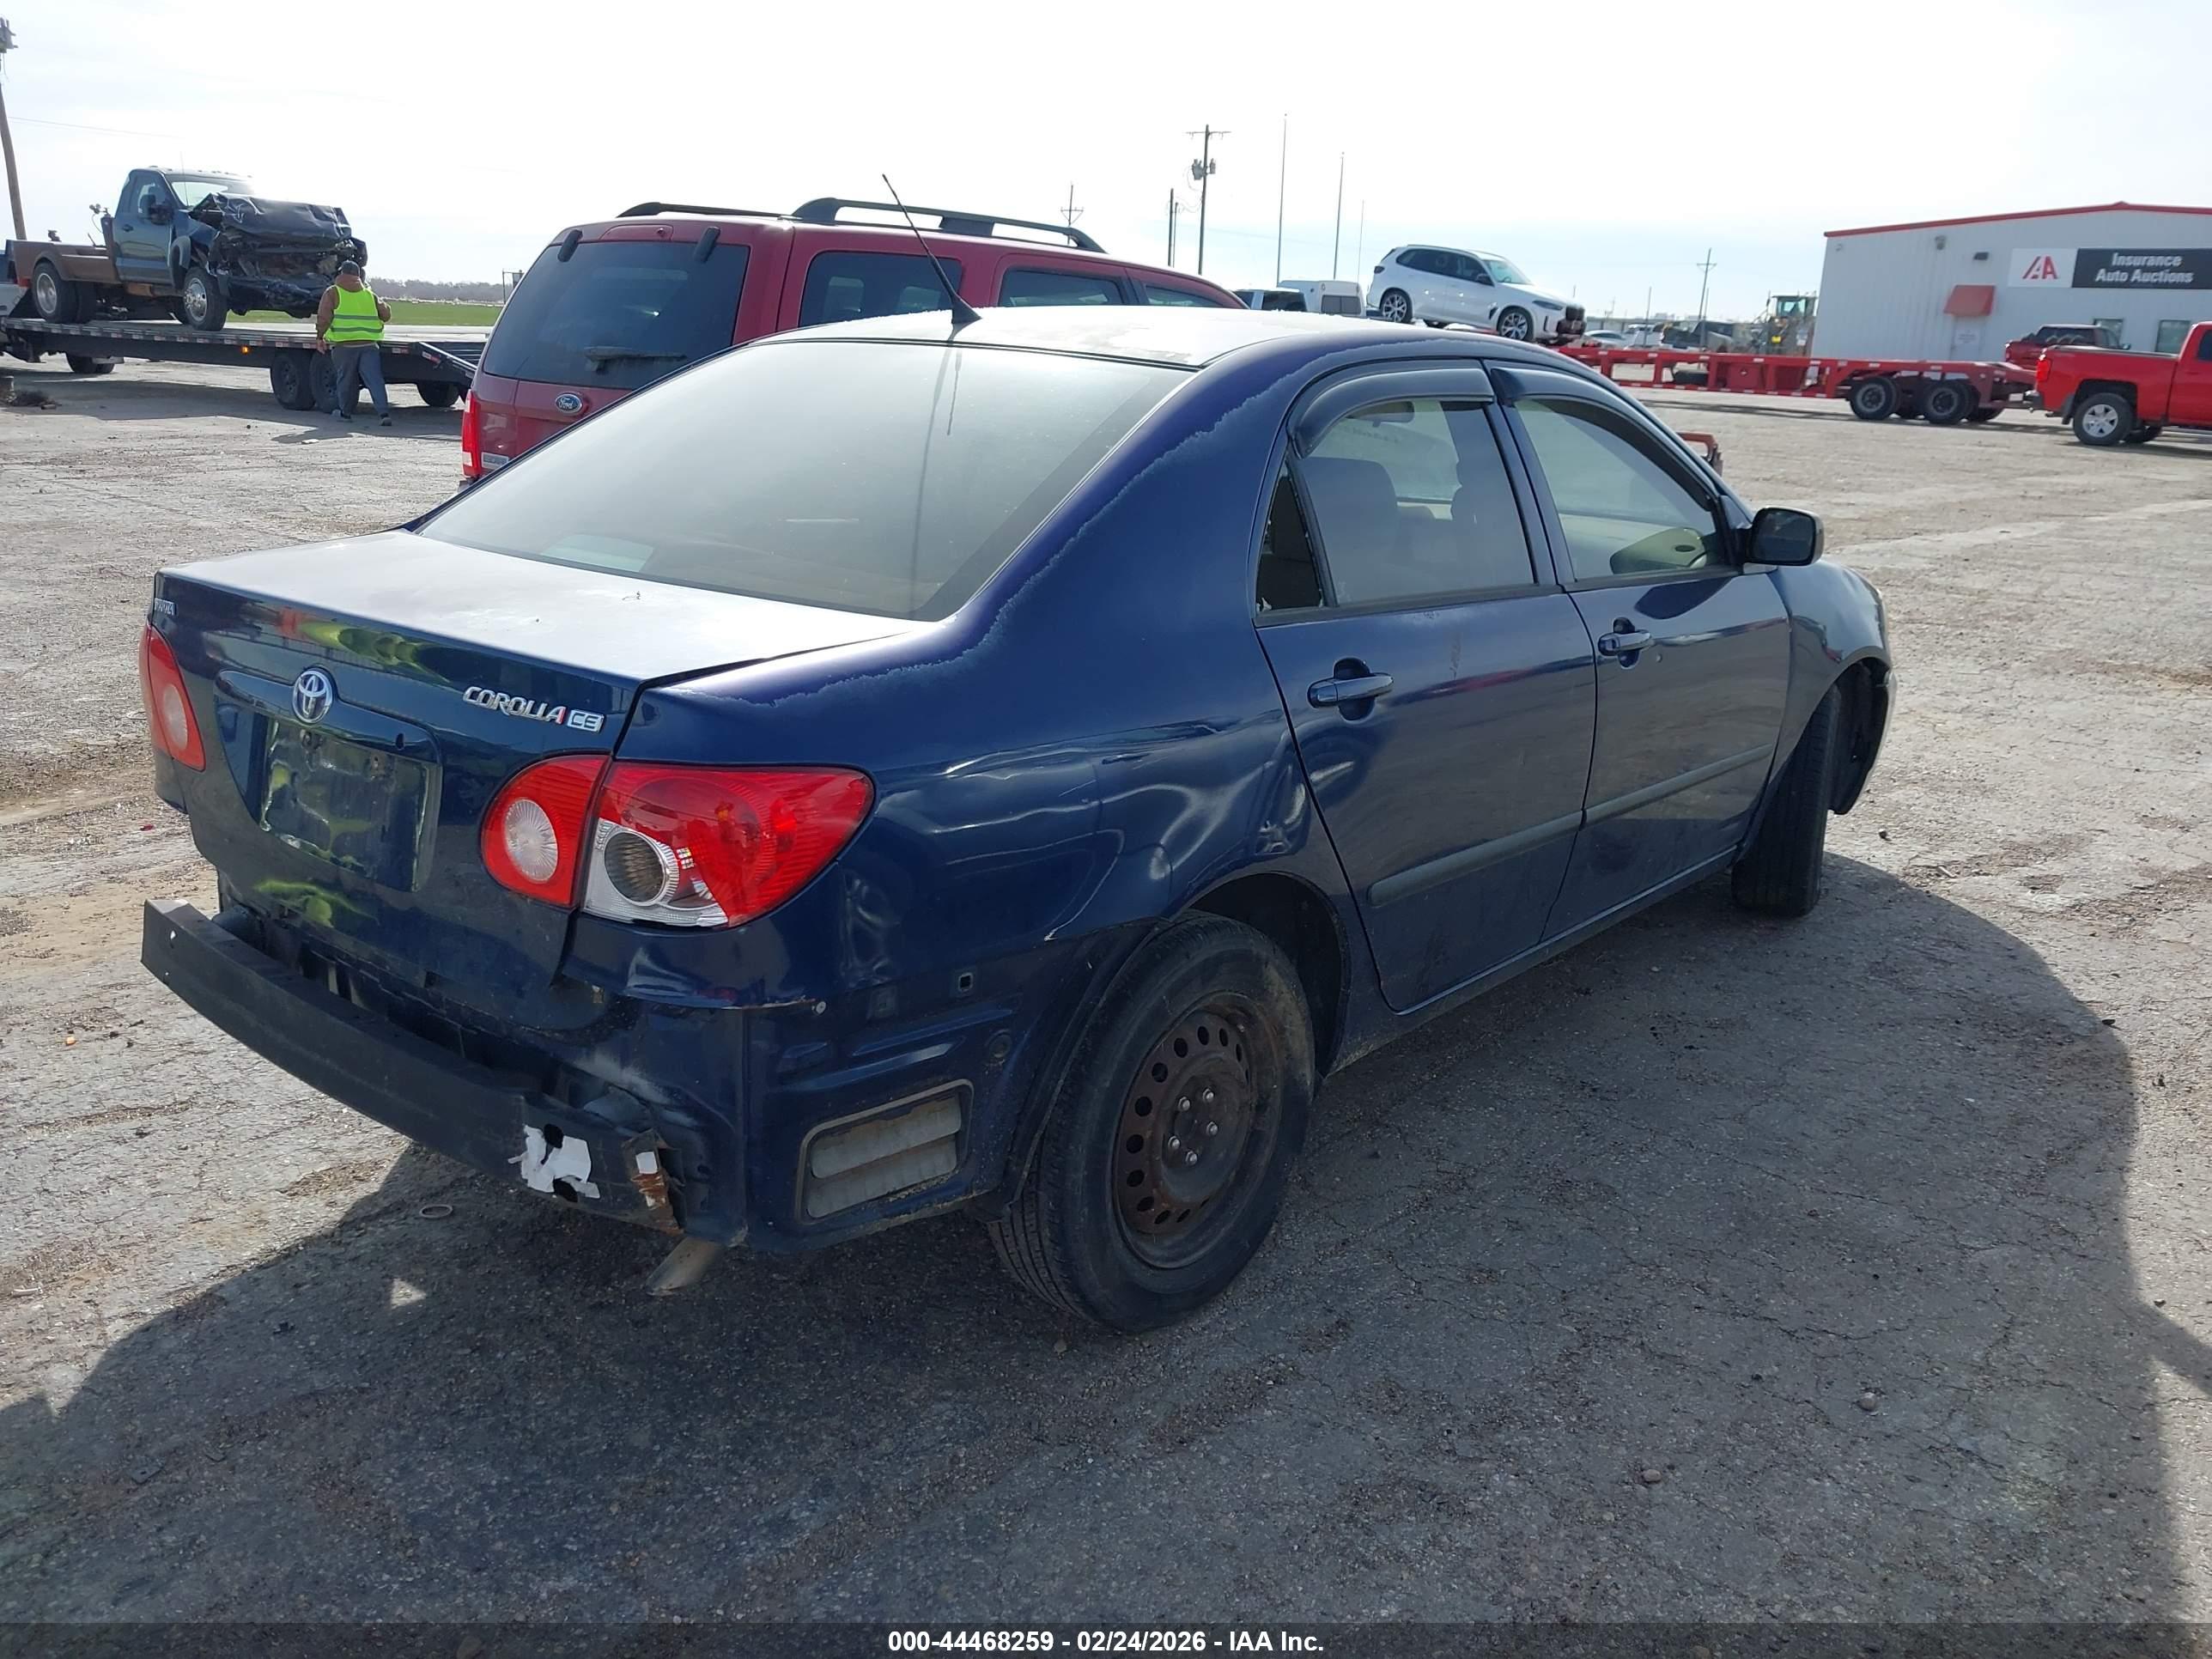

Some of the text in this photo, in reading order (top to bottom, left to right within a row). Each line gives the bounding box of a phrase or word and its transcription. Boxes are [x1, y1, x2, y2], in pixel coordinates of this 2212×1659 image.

[2112, 252, 2182, 266] Insurance
[2095, 268, 2195, 283] Auto Auctions
[558, 397, 574, 409] Ford
[462, 685, 602, 731] COROLLA CE
